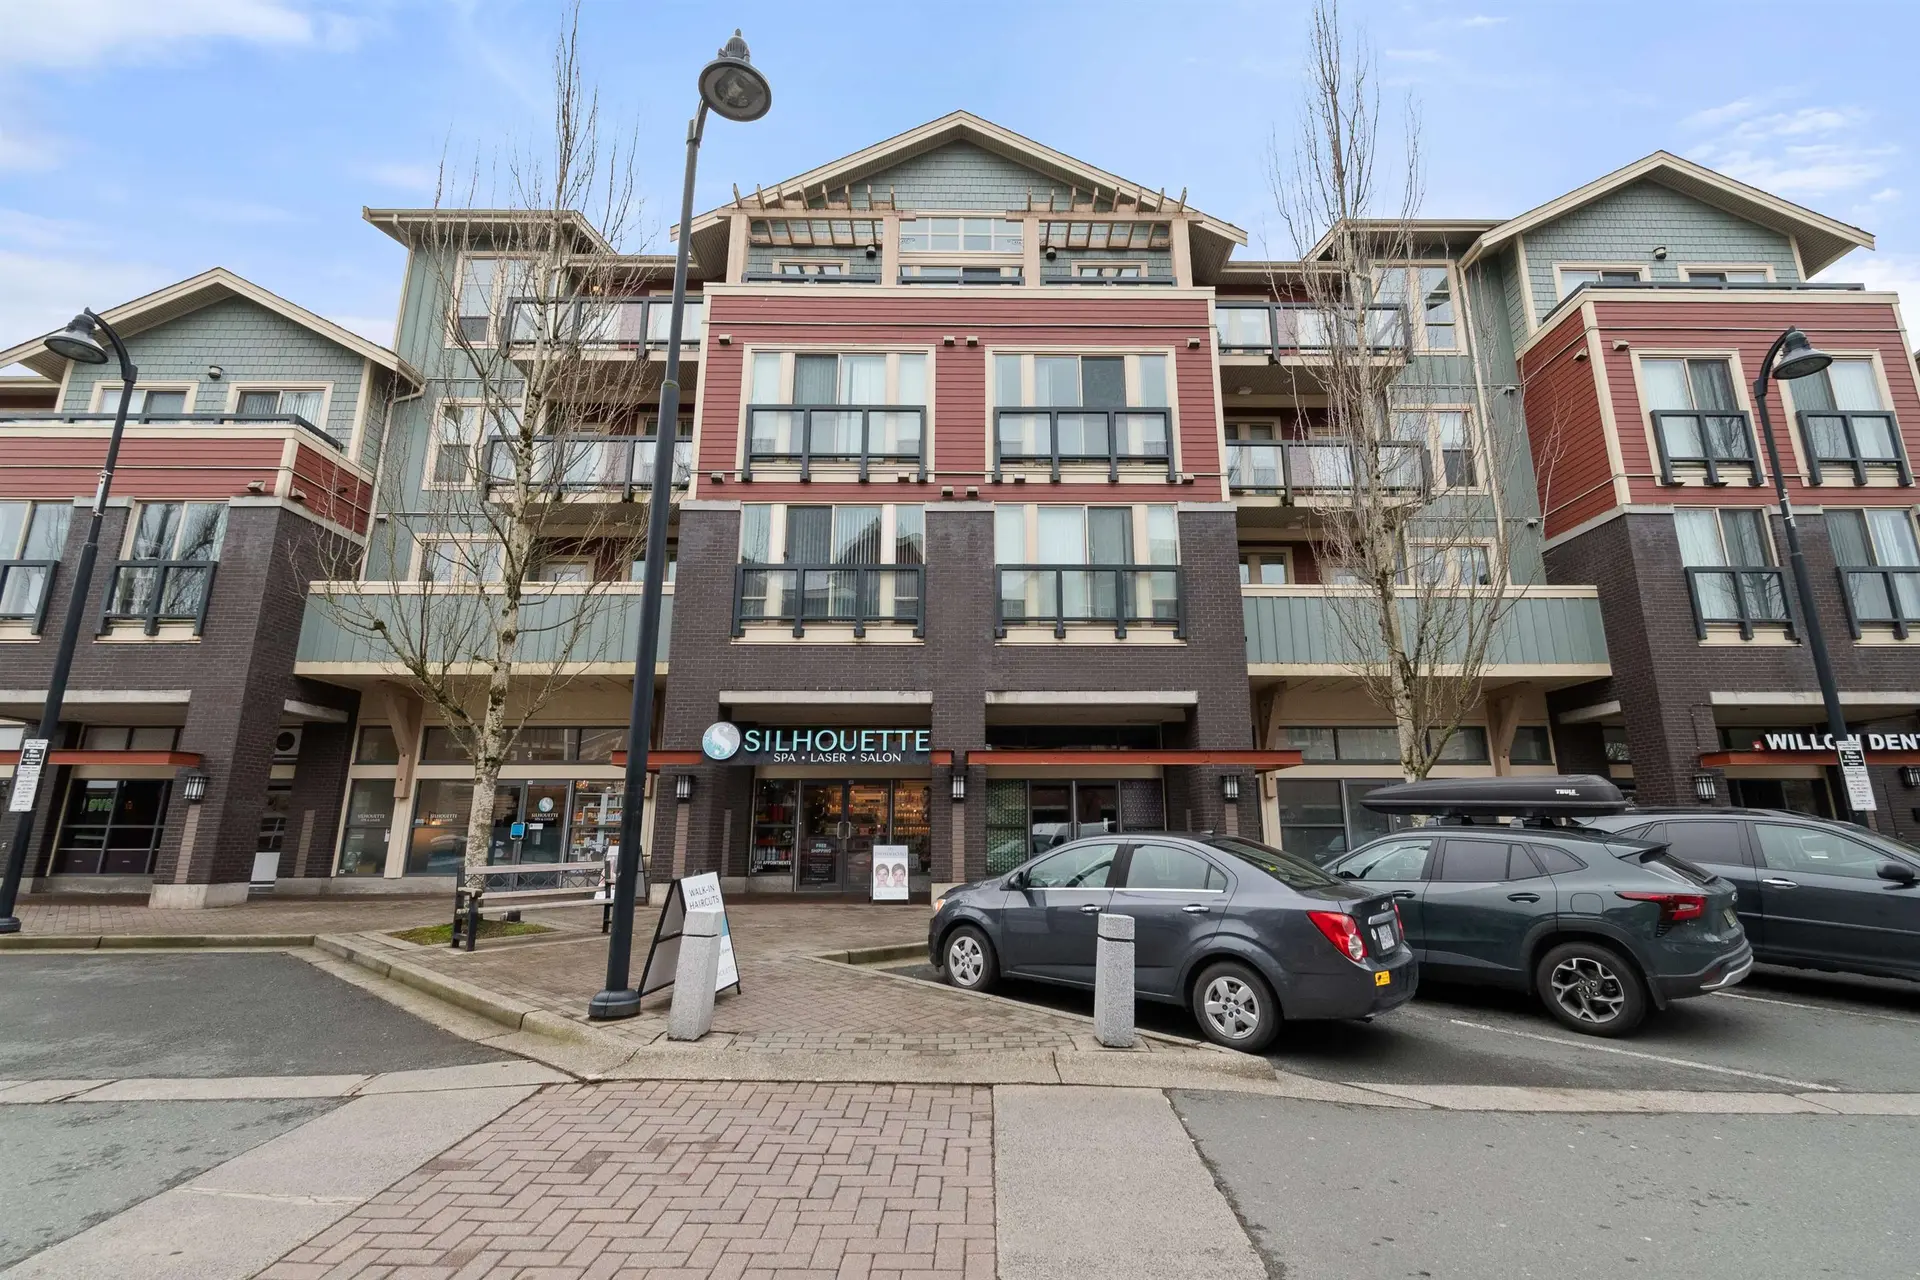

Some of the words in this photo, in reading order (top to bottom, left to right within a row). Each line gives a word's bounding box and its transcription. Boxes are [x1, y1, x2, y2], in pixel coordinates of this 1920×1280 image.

[743, 730, 930, 752] SILHOUETTE
[773, 752, 796, 763] SPA
[810, 752, 847, 763] LASER
[860, 752, 902, 763] SALON
[689, 884, 715, 897] WALK-IN
[689, 895, 720, 910] HAIRCUTS
